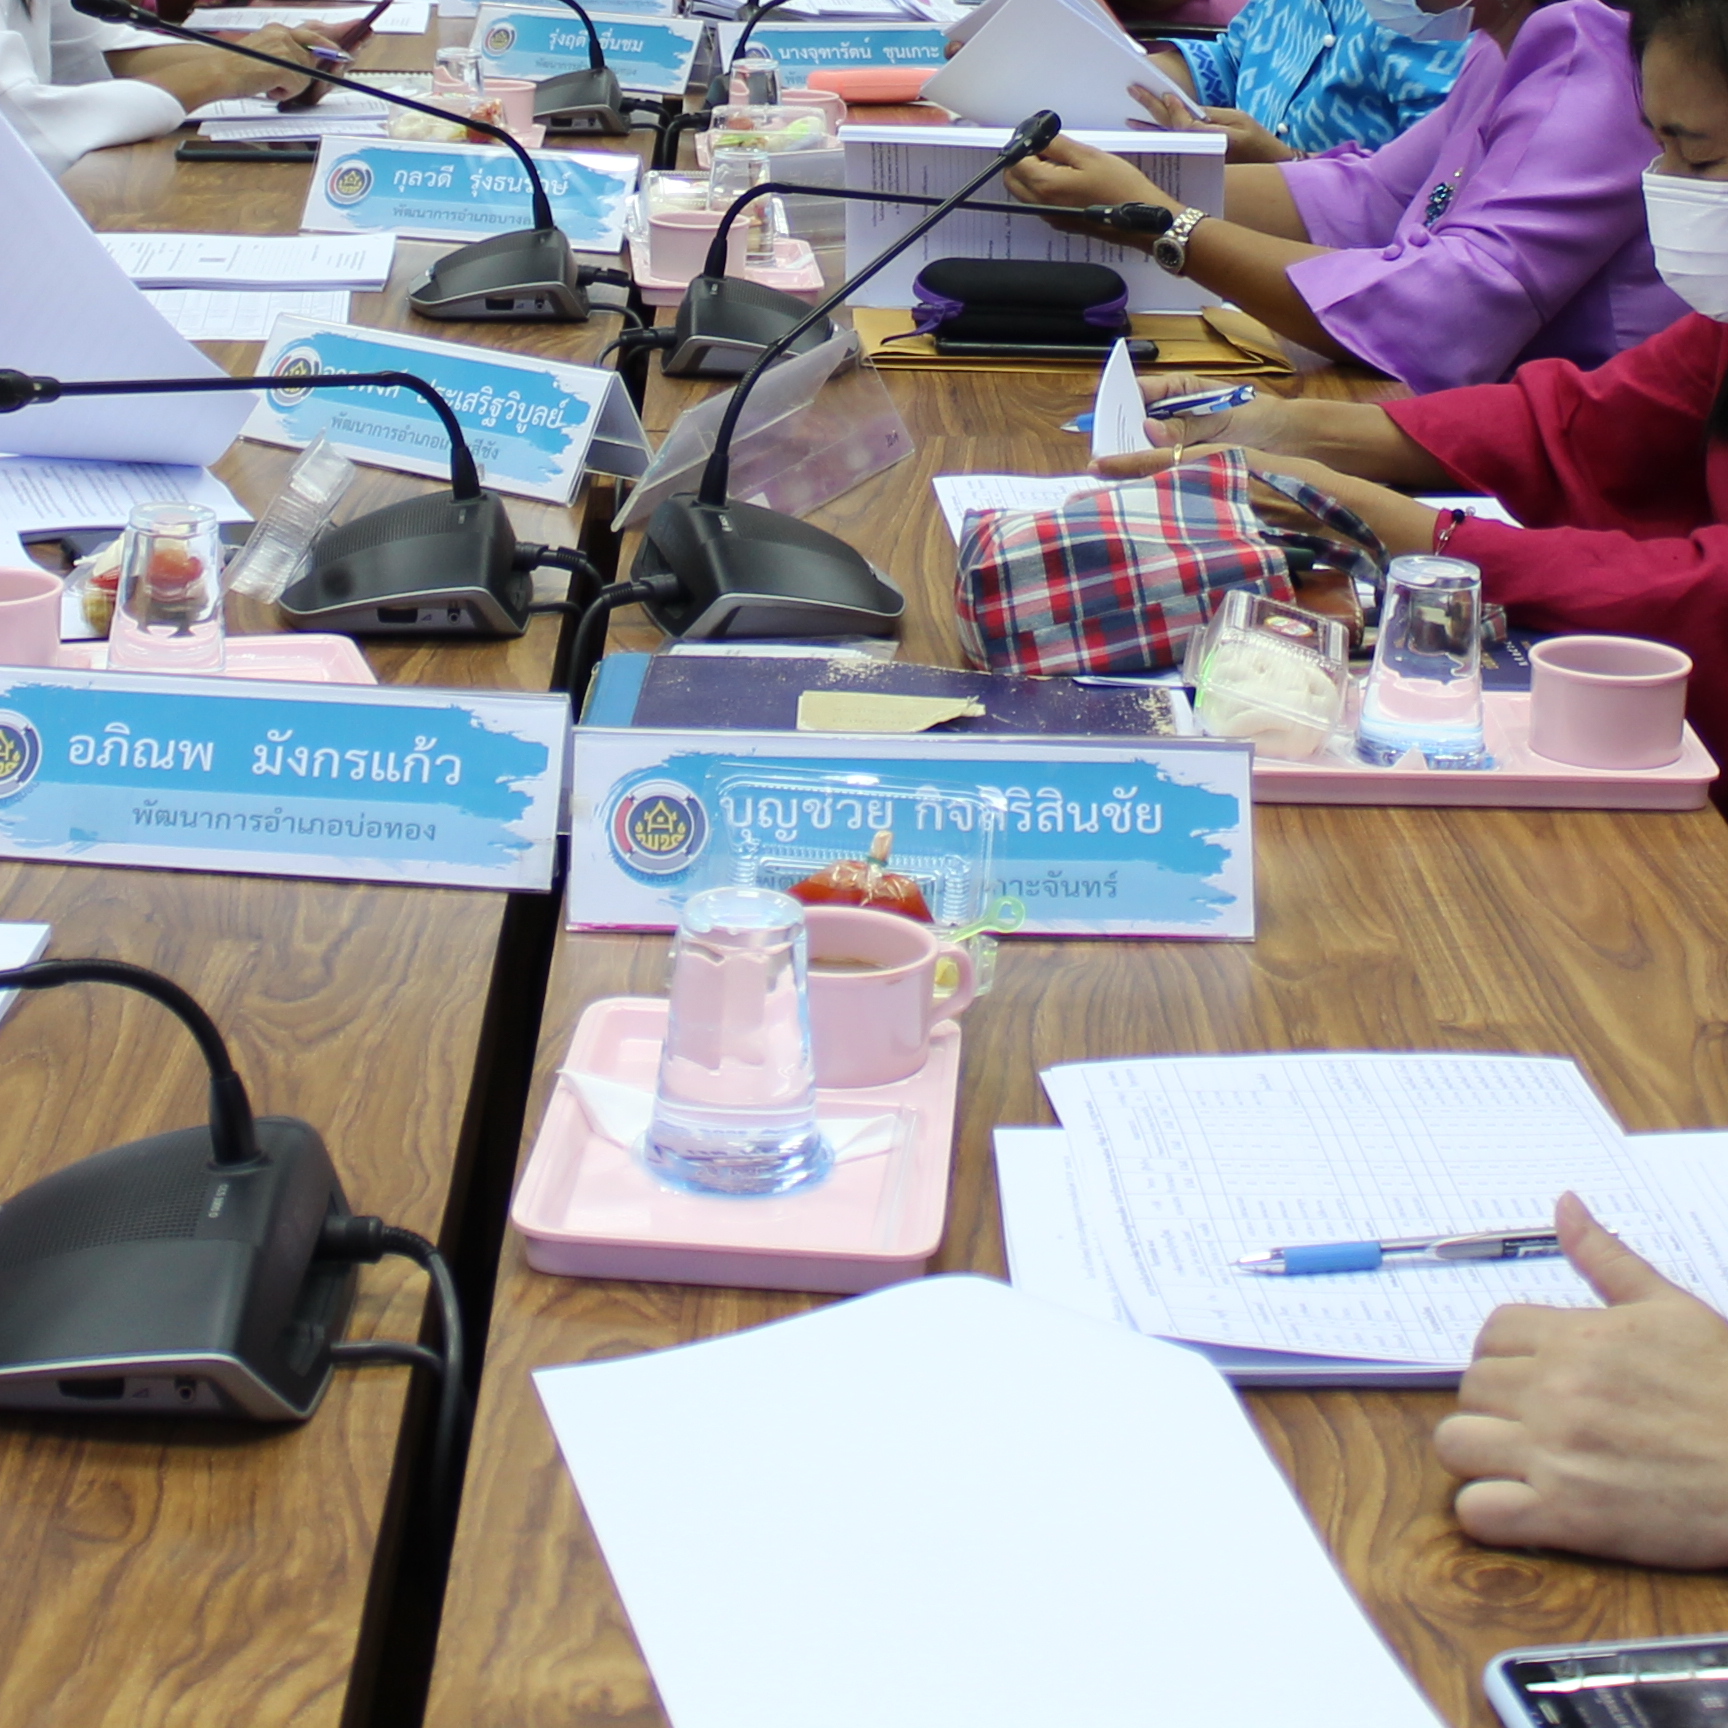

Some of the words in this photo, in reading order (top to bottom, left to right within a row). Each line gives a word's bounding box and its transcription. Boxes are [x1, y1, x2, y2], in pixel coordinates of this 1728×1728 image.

[393, 165, 454, 193] กุลวดี
[68, 721, 214, 774] อภิณพ
[252, 728, 462, 787] มังกรแก้ว
[132, 800, 437, 842] พัฒนาการอำเภอบ่อทอง
[720, 786, 894, 845] บุญช่วย
